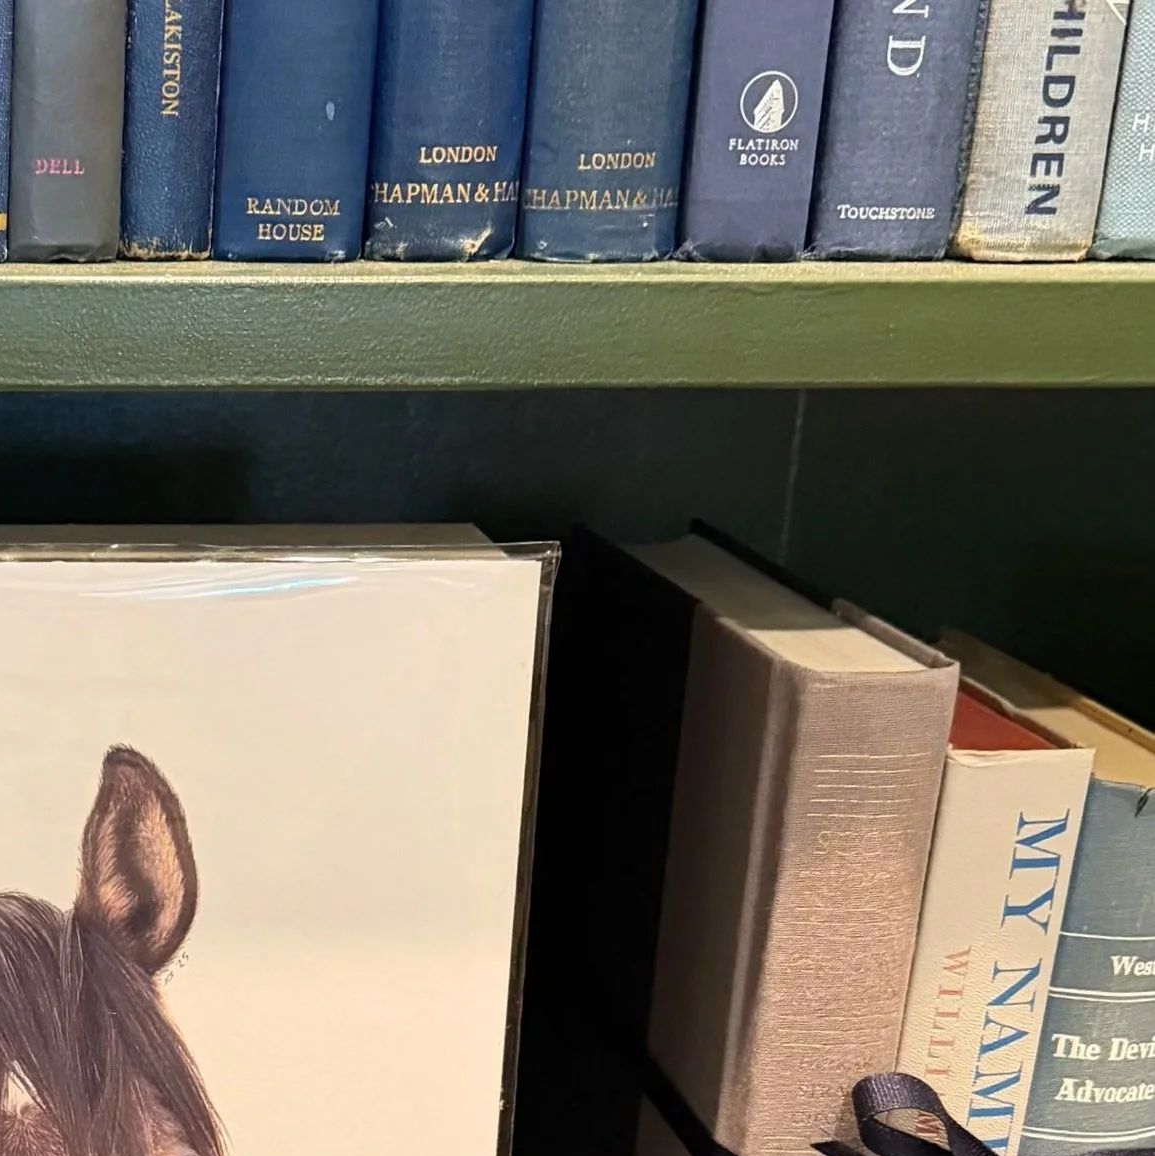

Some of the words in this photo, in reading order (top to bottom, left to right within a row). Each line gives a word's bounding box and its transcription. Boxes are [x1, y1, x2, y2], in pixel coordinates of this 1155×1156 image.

[729, 138, 799, 152] FLATIRON
[419, 146, 498, 164] LONDON
[577, 152, 657, 170] LONDON
[739, 154, 786, 166] BOOKS
[35, 159, 85, 176] DELL
[372, 181, 472, 205] HAPMAN
[474, 182, 490, 203] &
[632, 190, 648, 210] &
[246, 198, 340, 217] RANDOM
[837, 204, 935, 221] TOUCHSTONE
[257, 224, 325, 242] HOUSE
[999, 807, 1071, 935] MY
[916, 944, 971, 1136] WILLIM
[1051, 1033, 1101, 1061] The
[1054, 1077, 1155, 1104] Advocate
